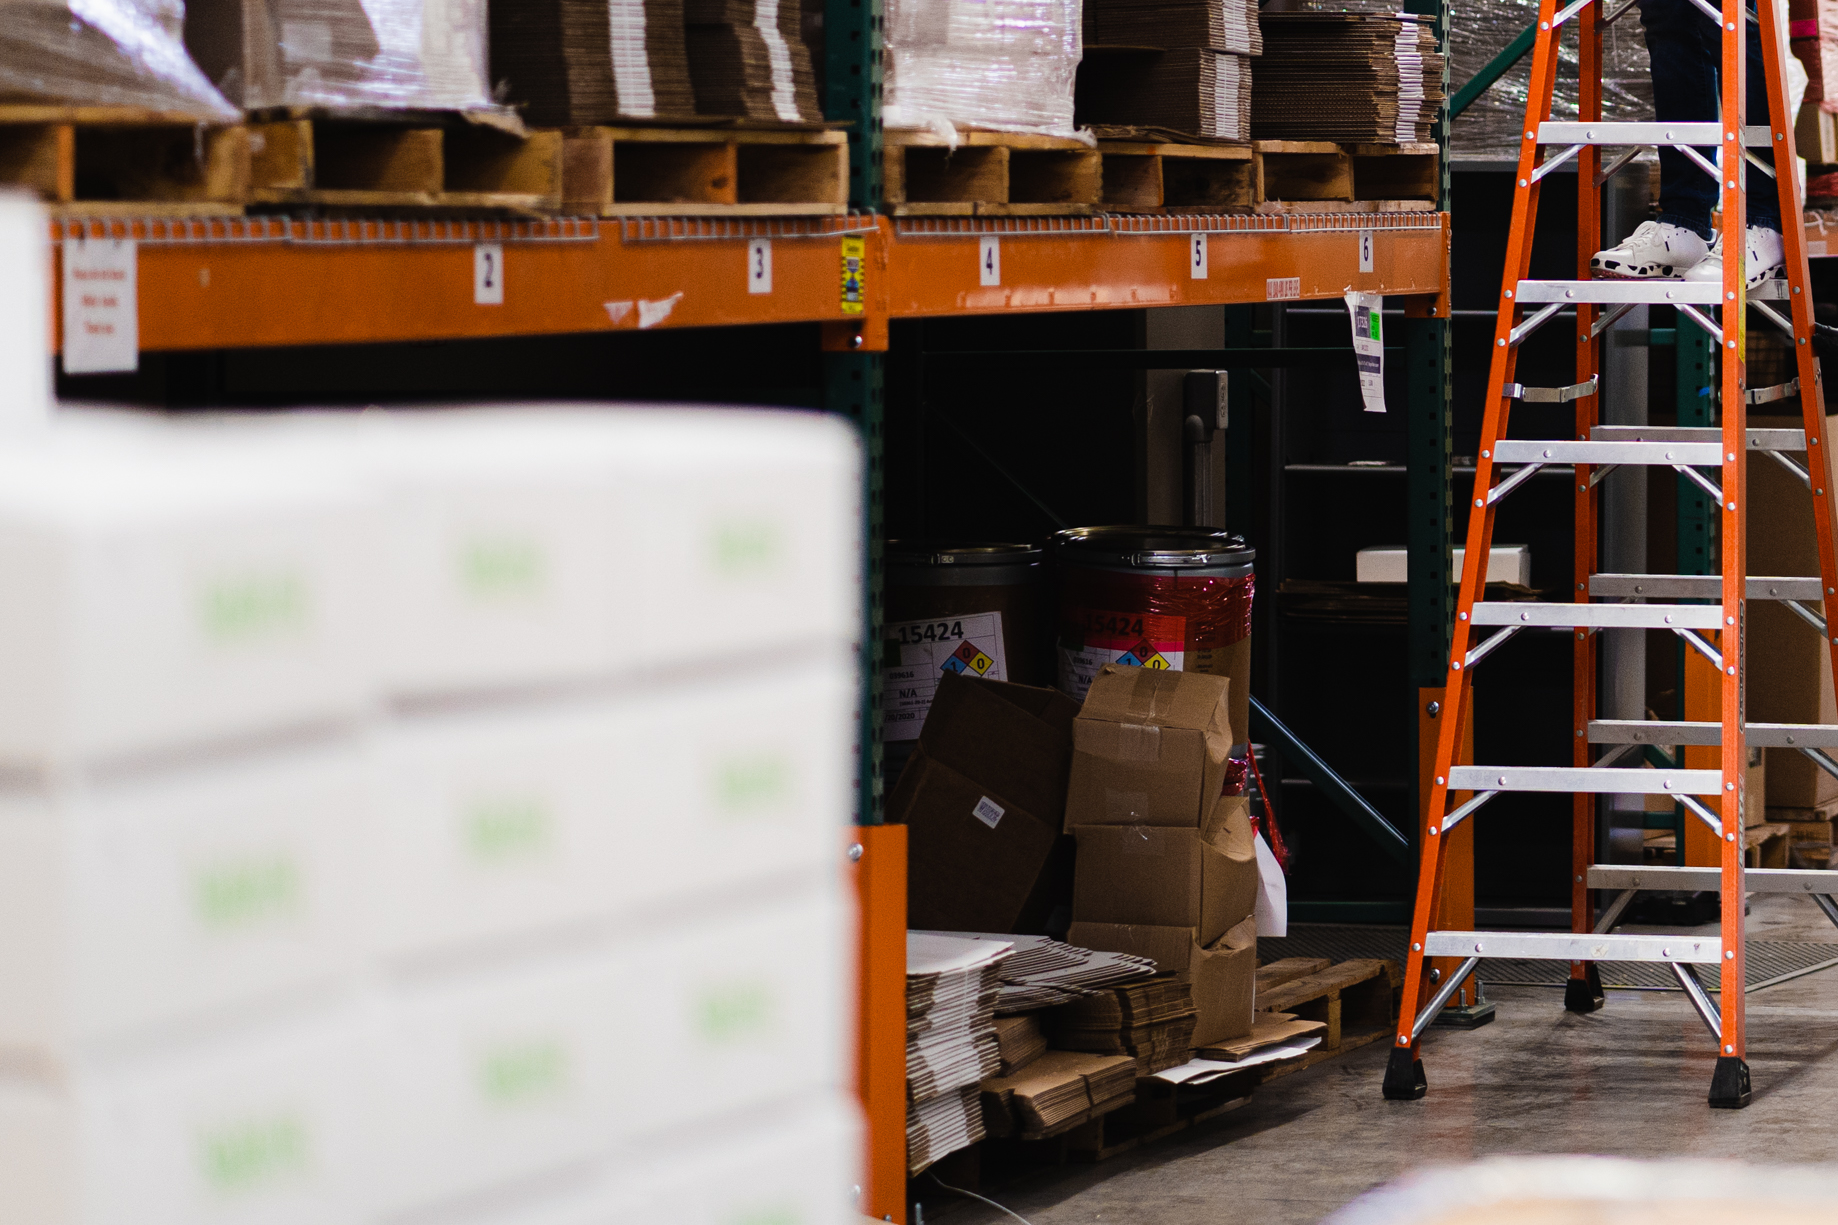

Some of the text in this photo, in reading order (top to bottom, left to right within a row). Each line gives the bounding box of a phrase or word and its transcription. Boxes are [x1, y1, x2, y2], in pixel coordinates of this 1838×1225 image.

[1195, 240, 1202, 267] 5
[1363, 236, 1369, 261] 6
[483, 252, 494, 288] 2
[756, 247, 763, 279] 3
[985, 246, 993, 275] 4
[898, 621, 964, 644] 15424
[1086, 614, 1144, 636] 15424
[962, 647, 971, 659] 0
[1139, 646, 1147, 657] 0
[950, 658, 985, 672] 1 0
[1078, 675, 1092, 685] N/A
[899, 688, 917, 698] N/A
[884, 713, 915, 722] /20/2020
